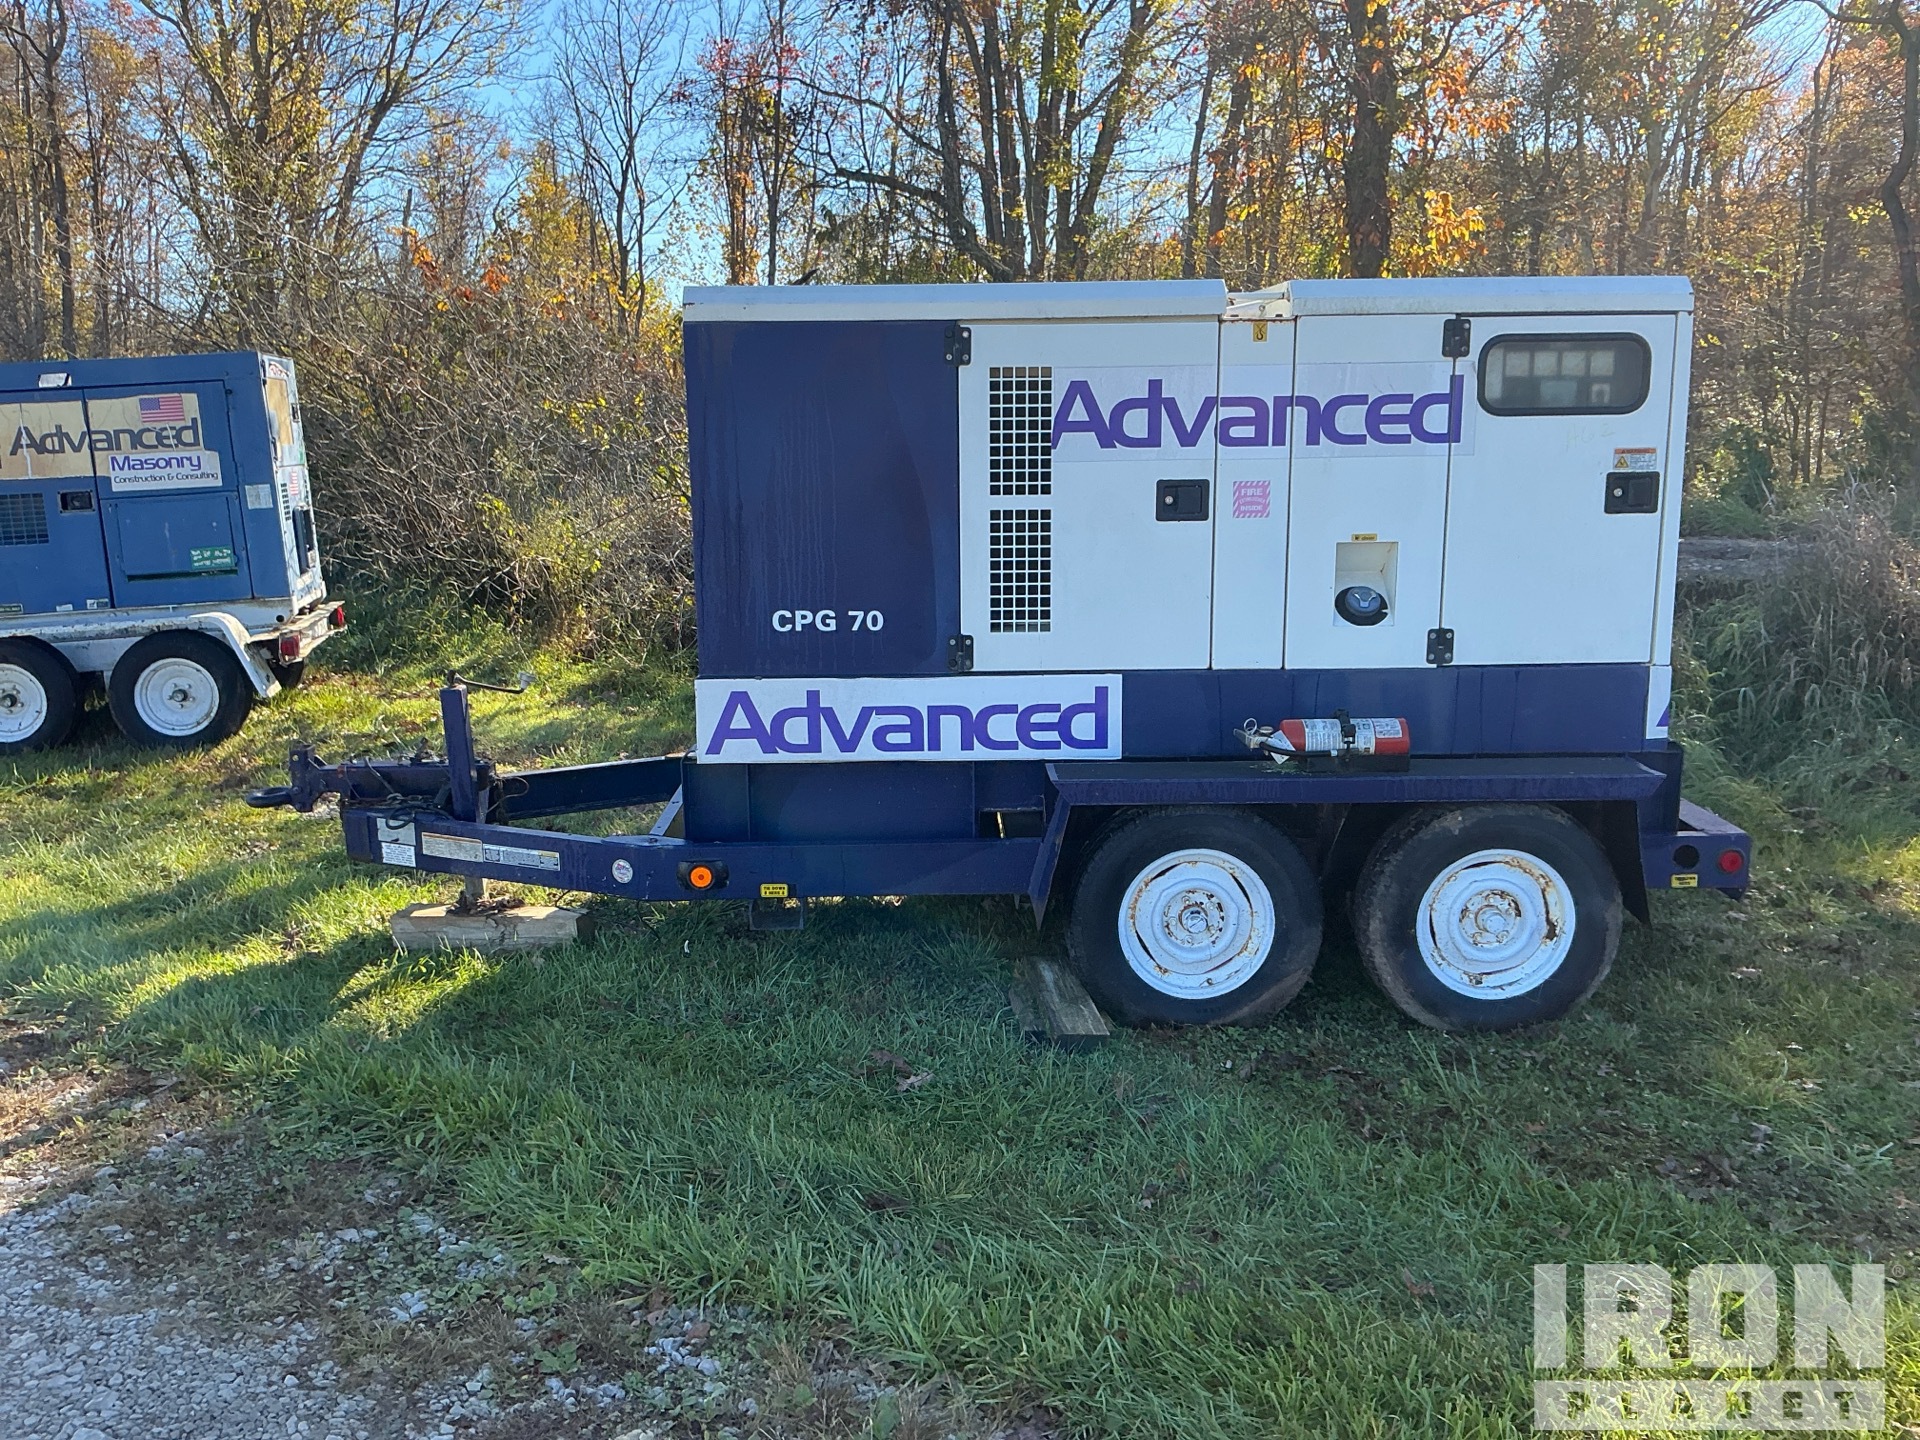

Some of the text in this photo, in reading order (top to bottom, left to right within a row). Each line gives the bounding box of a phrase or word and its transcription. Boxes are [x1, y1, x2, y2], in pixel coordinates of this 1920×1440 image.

[1051, 374, 1465, 449] Advanced
[9, 417, 201, 456] Advanced
[110, 455, 202, 472] Masonry
[113, 473, 166, 484] Construction
[175, 472, 218, 481] Consulting
[1241, 488, 1264, 496] FIRE
[771, 609, 885, 633] CPG 70
[705, 686, 1109, 755] Advanced
